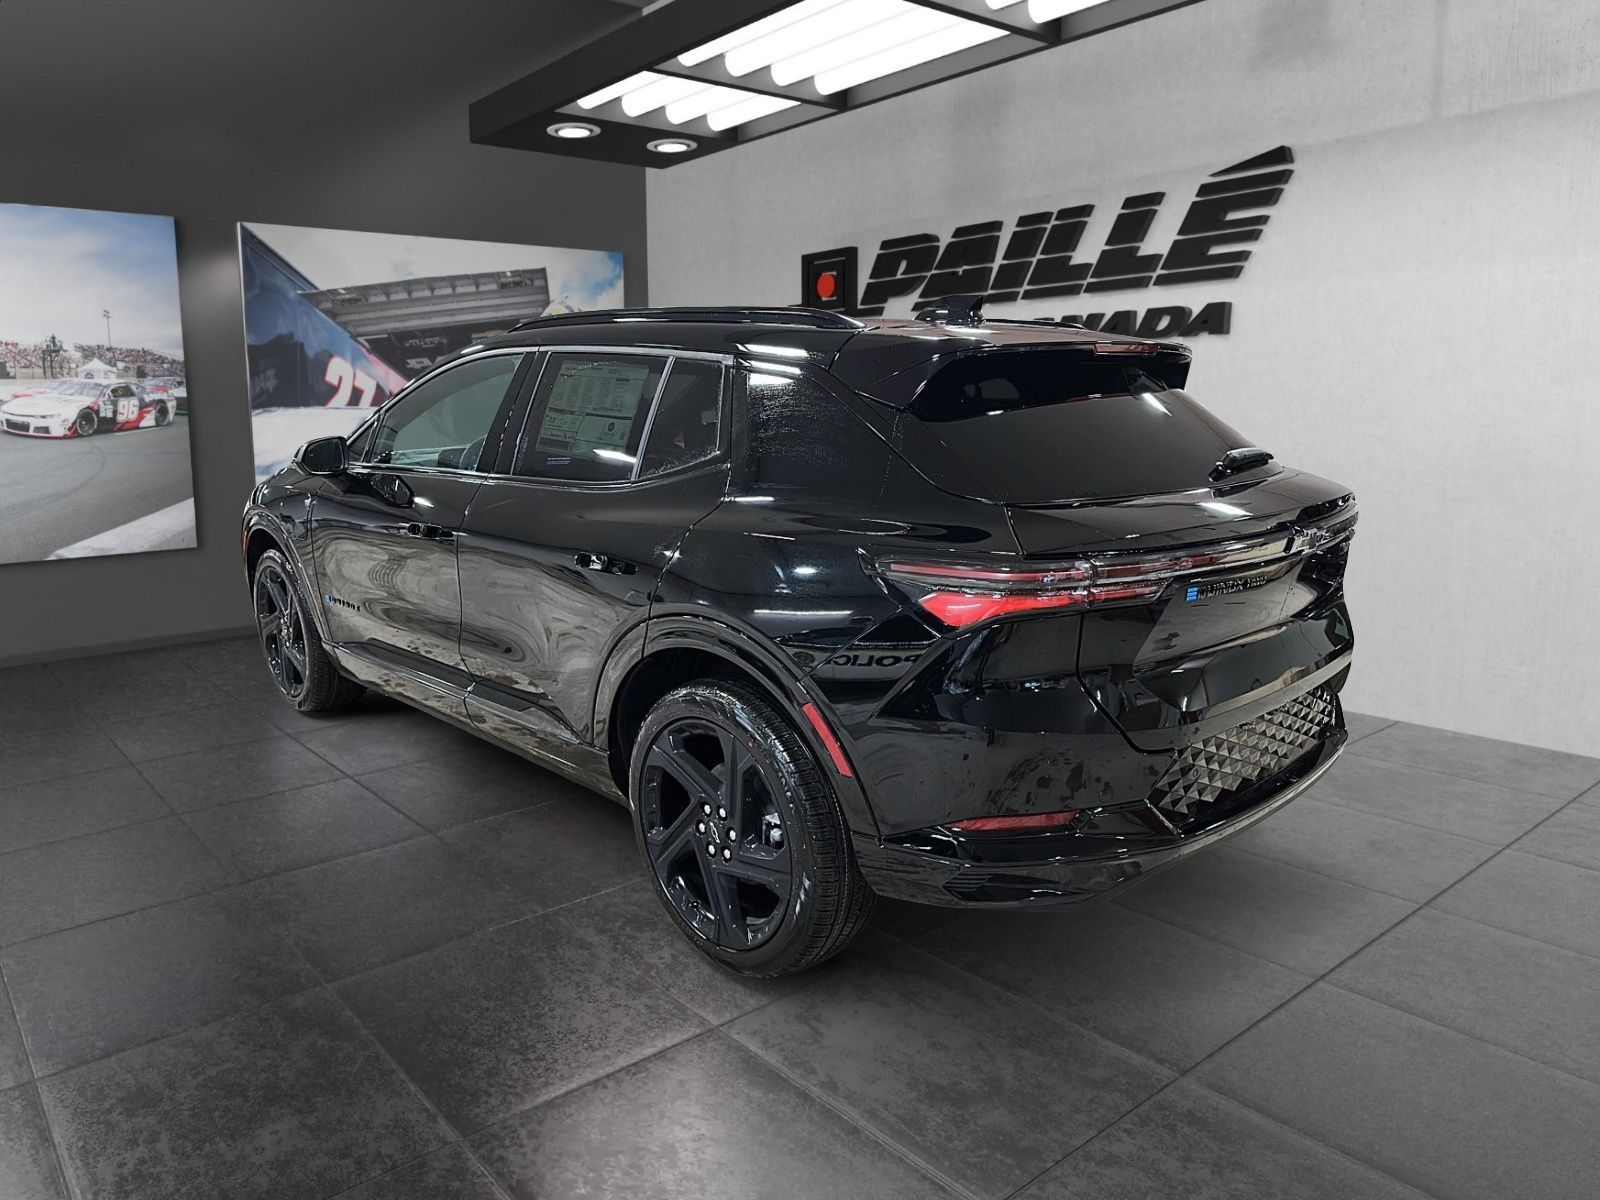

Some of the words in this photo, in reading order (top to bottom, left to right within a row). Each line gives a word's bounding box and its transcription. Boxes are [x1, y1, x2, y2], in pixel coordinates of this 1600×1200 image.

[856, 145, 1295, 318] PAILLÉ
[1034, 301, 1233, 338] NADA
[324, 355, 378, 408] 27
[116, 399, 140, 423] 96
